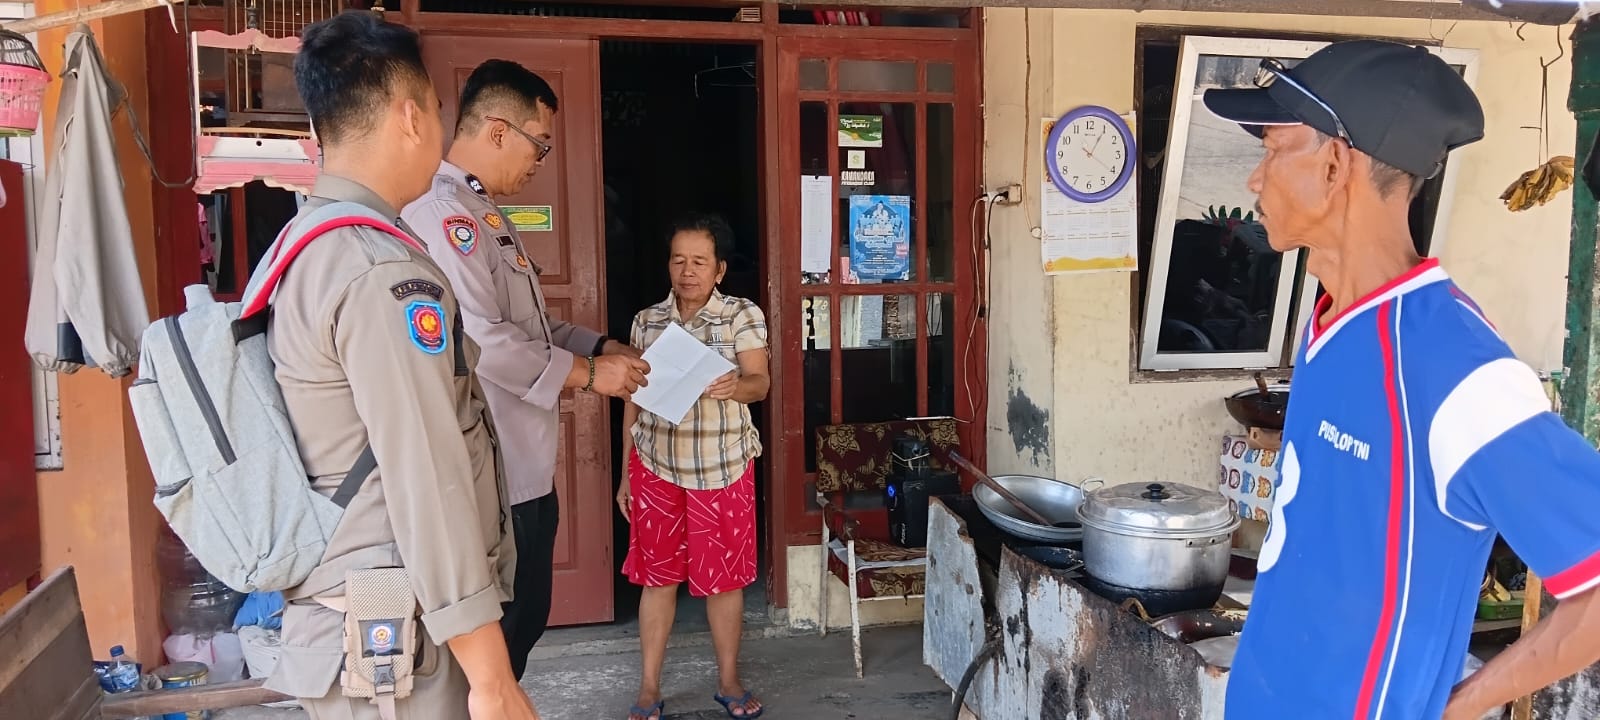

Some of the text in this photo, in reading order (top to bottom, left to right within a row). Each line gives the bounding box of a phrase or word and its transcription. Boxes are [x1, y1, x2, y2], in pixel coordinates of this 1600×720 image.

[1073, 125, 1079, 134] 11
[1086, 121, 1094, 130] 12
[1102, 124, 1106, 134] 1
[1062, 135, 1071, 145] 10
[1111, 135, 1117, 144] 2
[1057, 150, 1064, 159] 9
[1115, 150, 1121, 160] 3
[1062, 165, 1068, 175] 8
[1110, 166, 1116, 175] 4
[1073, 176, 1079, 184] 7
[1100, 176, 1106, 185] 5
[1086, 181, 1092, 190] 6
[1353, 439, 1371, 461] TNI
